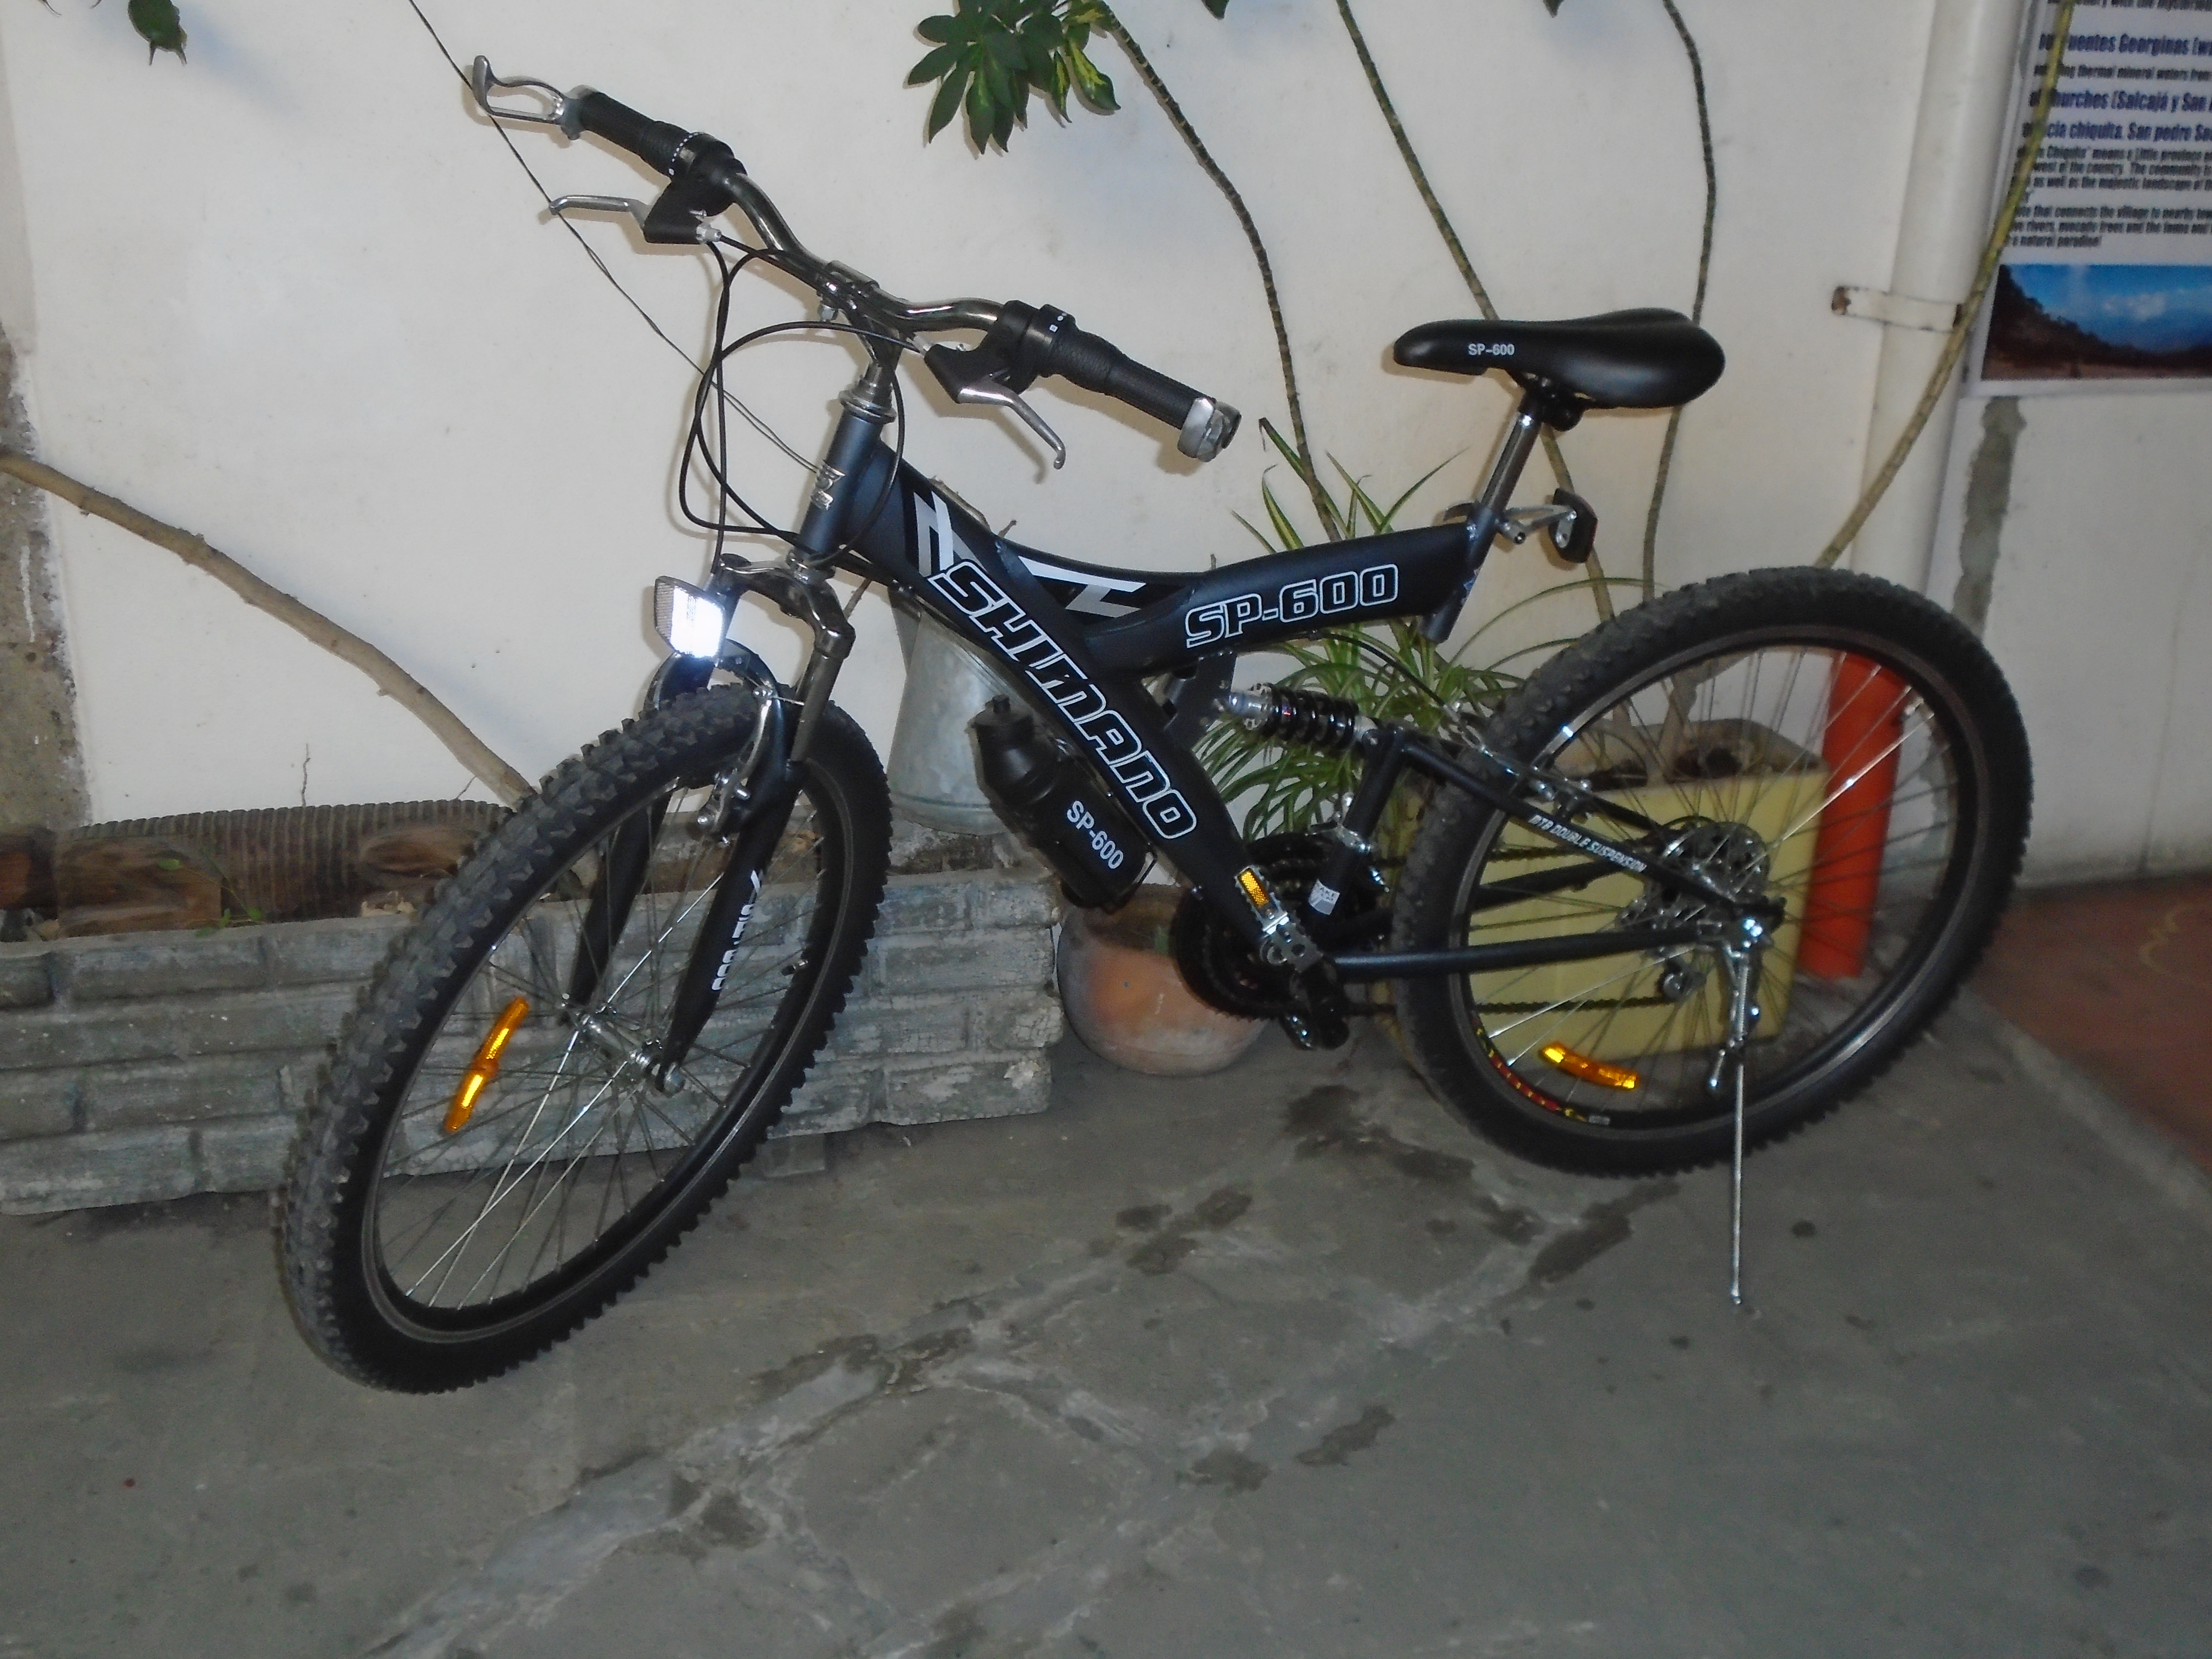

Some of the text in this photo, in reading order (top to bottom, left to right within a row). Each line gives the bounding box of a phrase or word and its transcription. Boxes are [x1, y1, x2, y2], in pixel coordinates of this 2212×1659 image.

[2063, 34, 2117, 52] uentes
[1468, 343, 1515, 356] SP-600
[1185, 563, 1398, 648] SP-600
[927, 560, 1197, 839] SHIMANO
[1066, 800, 1124, 869] SP-600
